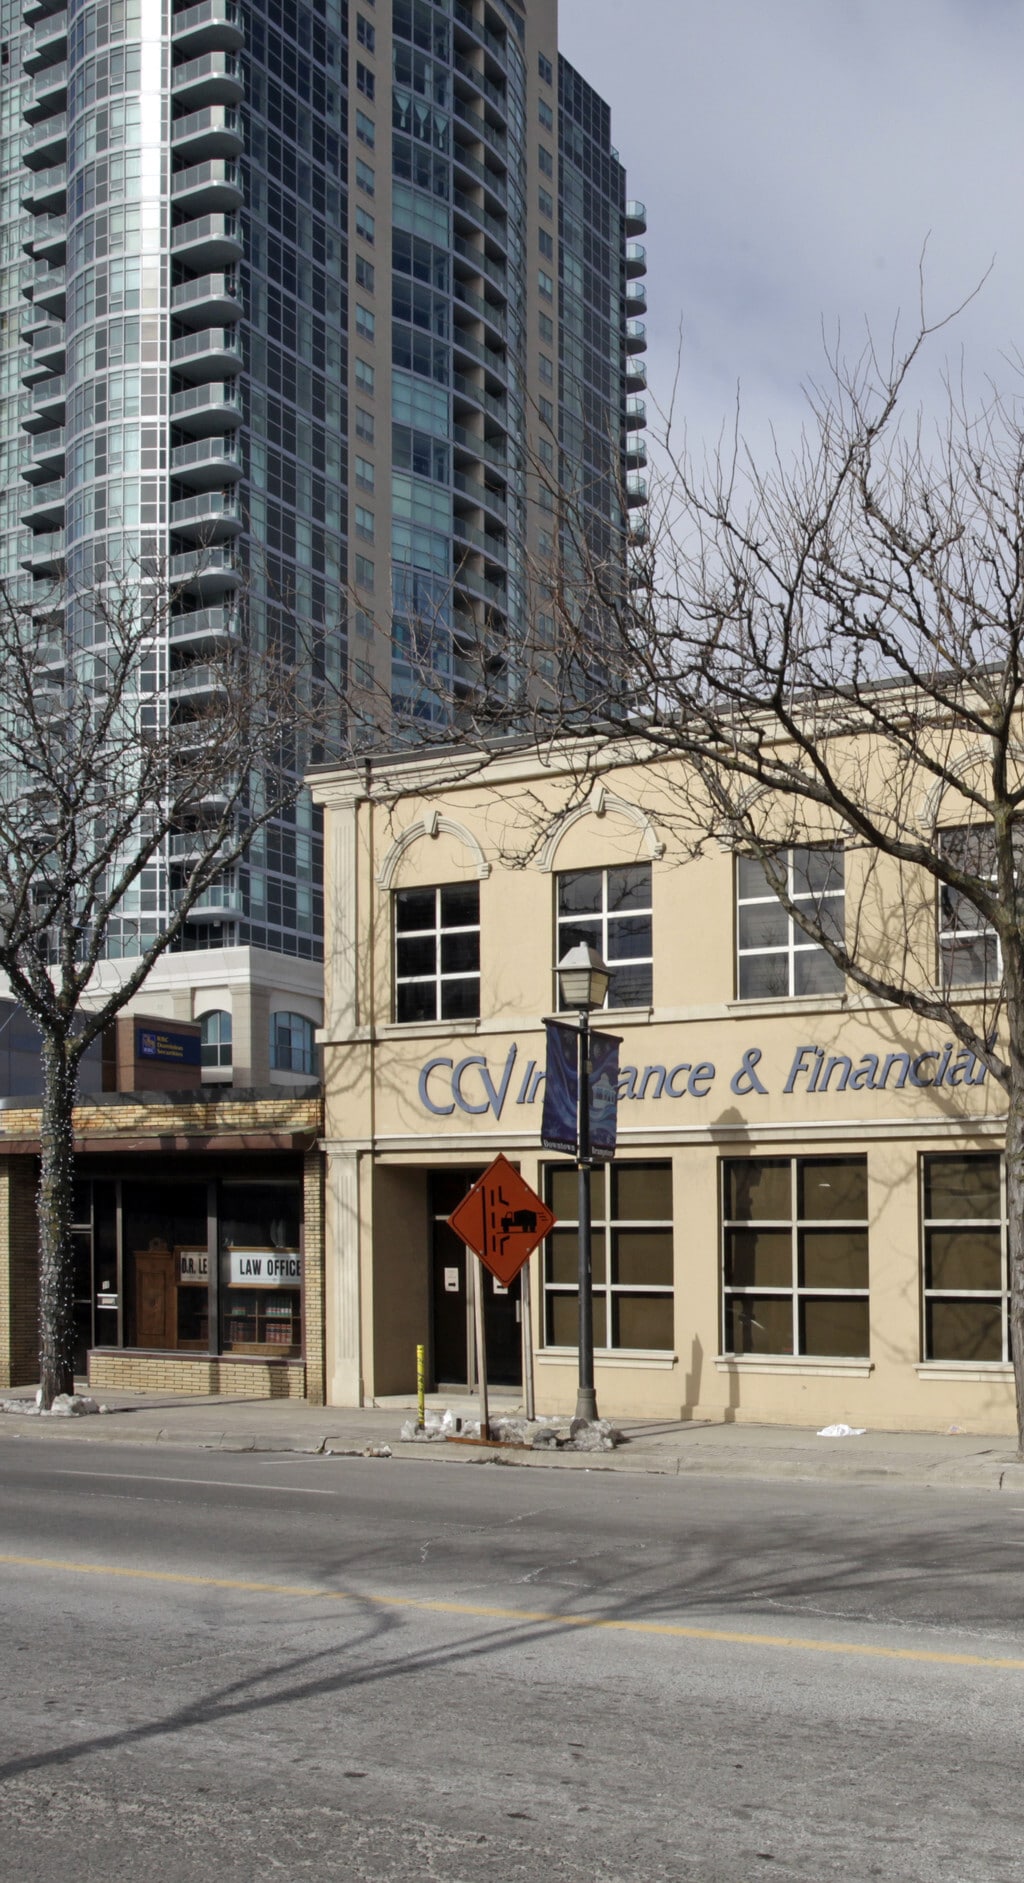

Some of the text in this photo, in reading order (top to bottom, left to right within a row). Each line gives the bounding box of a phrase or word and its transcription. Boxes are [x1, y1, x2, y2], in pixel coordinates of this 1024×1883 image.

[418, 1042, 517, 1121] CCV
[516, 1060, 715, 1104] Inance
[730, 1047, 769, 1095] &
[782, 1032, 998, 1093] Financial
[240, 1259, 262, 1275] LAW
